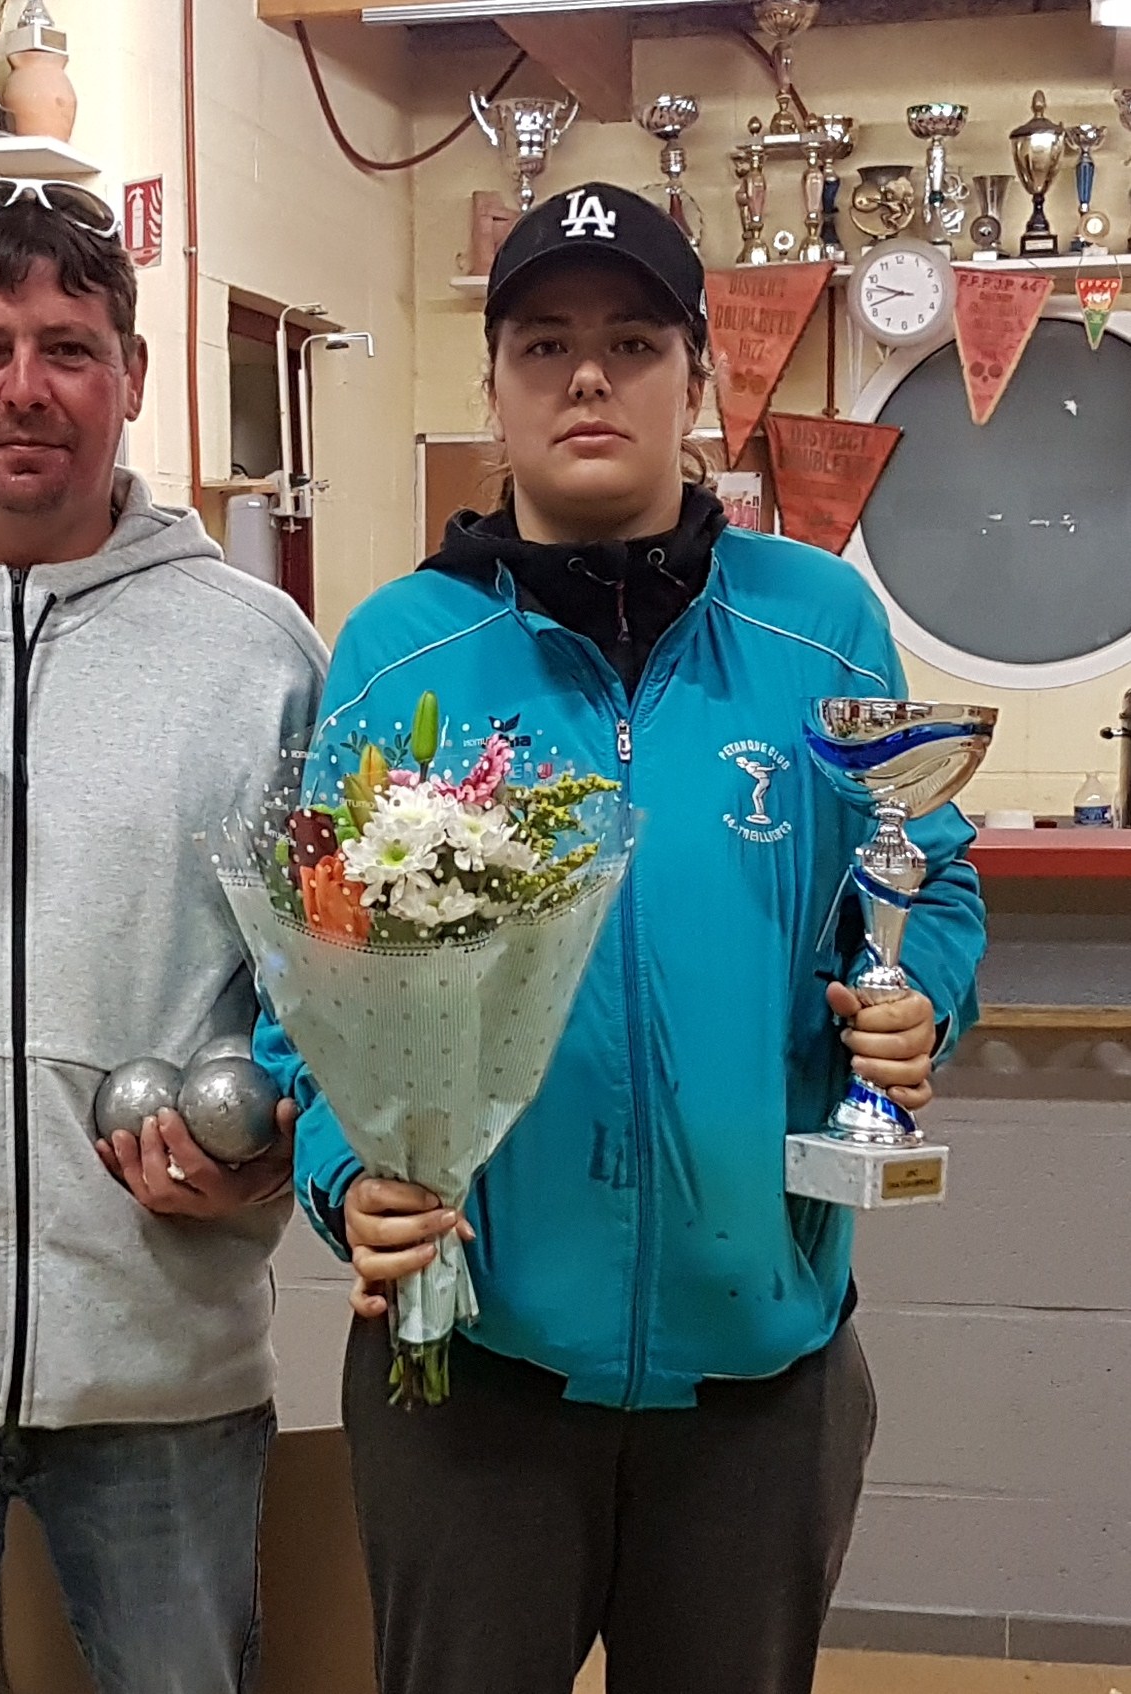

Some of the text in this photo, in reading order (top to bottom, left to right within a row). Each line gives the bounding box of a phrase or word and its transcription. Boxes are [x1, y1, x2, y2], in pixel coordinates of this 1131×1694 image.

[561, 189, 616, 238] LA
[895, 255, 905, 264] 12
[914, 258, 919, 267] 1
[880, 262, 888, 271] 11
[927, 268, 934, 278] 2
[868, 274, 878, 284] 10
[932, 284, 939, 294] 3
[866, 291, 872, 301] 9
[929, 302, 935, 310] 4
[872, 308, 878, 317] 8
[885, 317, 891, 327] 7
[917, 314, 924, 324] 5
[901, 321, 908, 331] 6
[718, 739, 768, 760] PETANQUE
